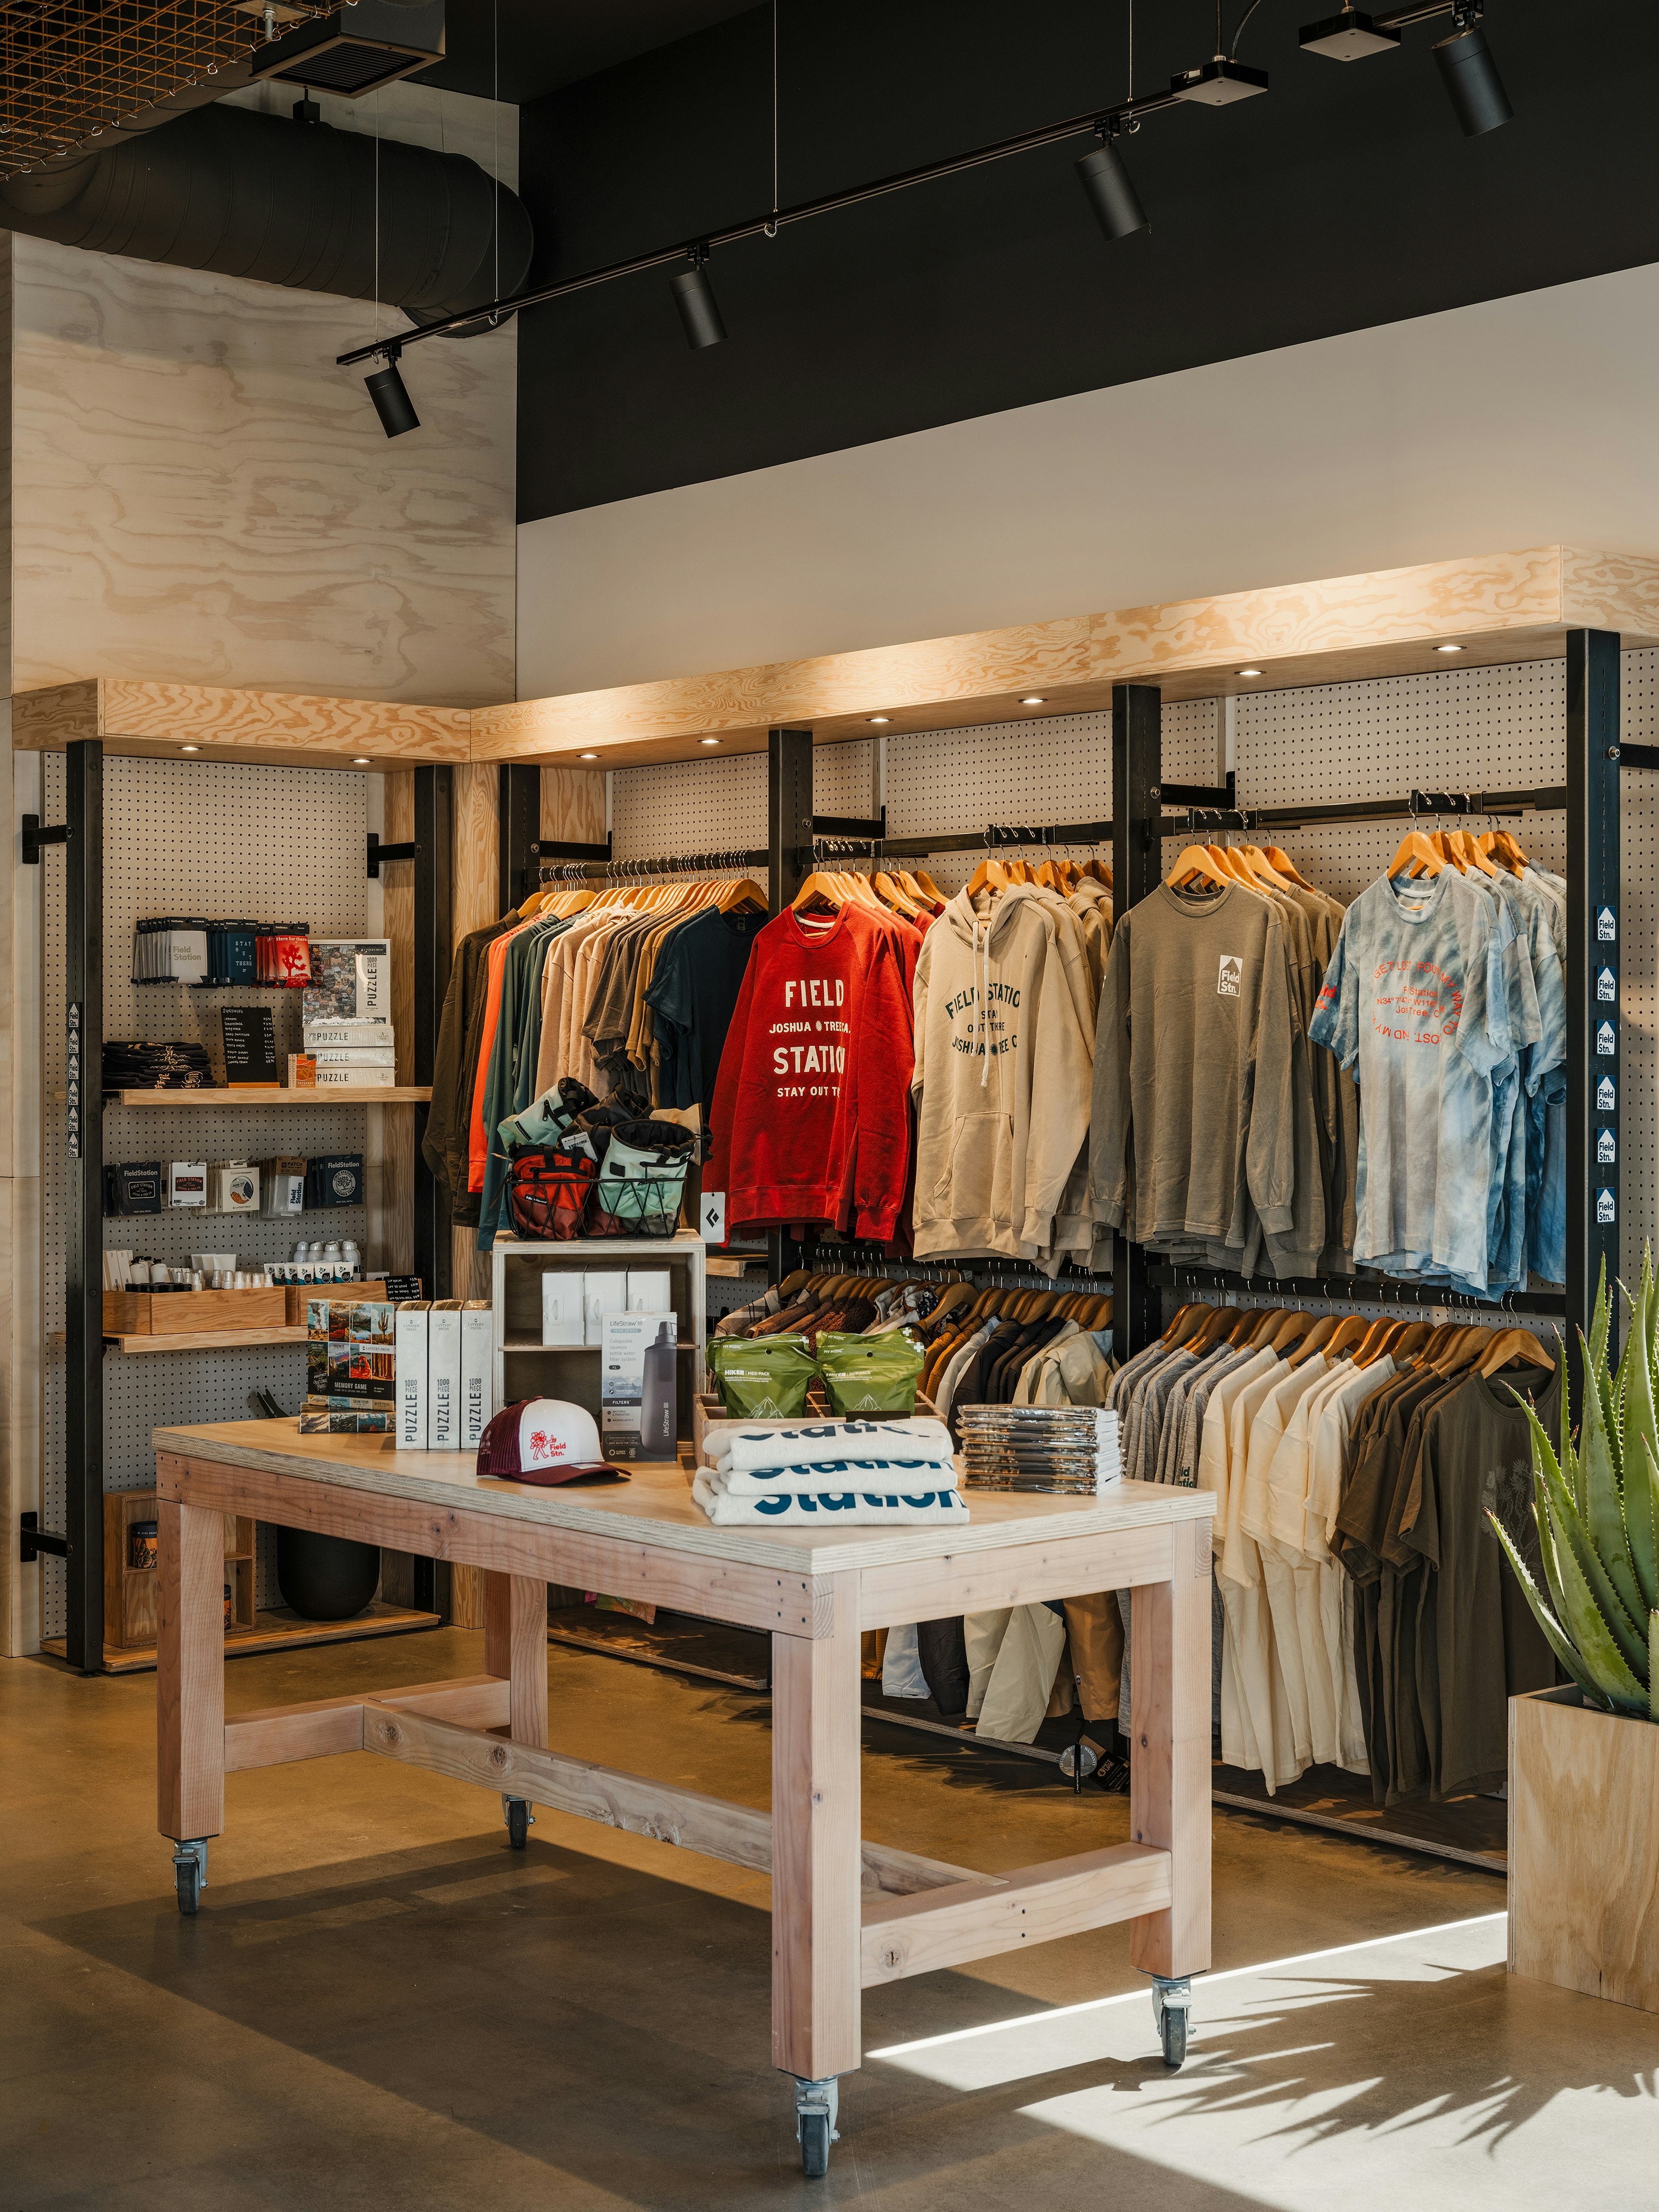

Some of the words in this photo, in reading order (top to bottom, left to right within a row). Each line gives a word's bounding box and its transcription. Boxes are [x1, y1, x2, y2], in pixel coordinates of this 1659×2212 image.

[1599, 919, 1614, 929] Field
[1599, 930, 1612, 939] Stn.
[1374, 961, 1394, 979] GET
[1417, 962, 1441, 977] FOUD
[1222, 970, 1239, 983] Field
[1440, 973, 1457, 988] MY
[367, 969, 377, 1006] PUZZLE
[1220, 981, 1237, 994] Stn.
[1599, 979, 1614, 990] Field
[785, 979, 844, 1007] FIELD
[1410, 987, 1438, 997] Station
[1599, 990, 1611, 1000] Stn.
[945, 987, 980, 1020] FIELD
[988, 983, 1020, 1008] STATIO
[1451, 990, 1463, 1016] WAY
[1410, 1007, 1430, 1018] Tree,
[769, 1022, 811, 1034] JOSHUA
[968, 1024, 985, 1032] OT
[1443, 1020, 1459, 1035] TO
[317, 1032, 348, 1041] PUZZLE
[1599, 1034, 1614, 1044] Field
[1599, 1044, 1611, 1053] Stn.
[317, 1073, 348, 1082] PUZZLE
[777, 1087, 805, 1097] STAY
[810, 1086, 828, 1096] OUT
[1599, 1089, 1614, 1099] Field
[1599, 1099, 1611, 1109] Stn.
[1599, 1142, 1614, 1151] Field
[1599, 1152, 1611, 1161] Stn.
[1599, 1202, 1614, 1212] Field
[1599, 1212, 1611, 1221] Stn.
[405, 1395, 418, 1442] PUZZLE
[437, 1394, 449, 1441] PUZZLE
[469, 1393, 481, 1440] PUZZLE
[550, 1442, 566, 1451] Field
[1060, 1751, 1068, 1767] LIFETIME
[1084, 1747, 1095, 1766] WARRANTY
[1102, 1759, 1112, 1769] PICT
[1105, 1762, 1114, 1771] URE
